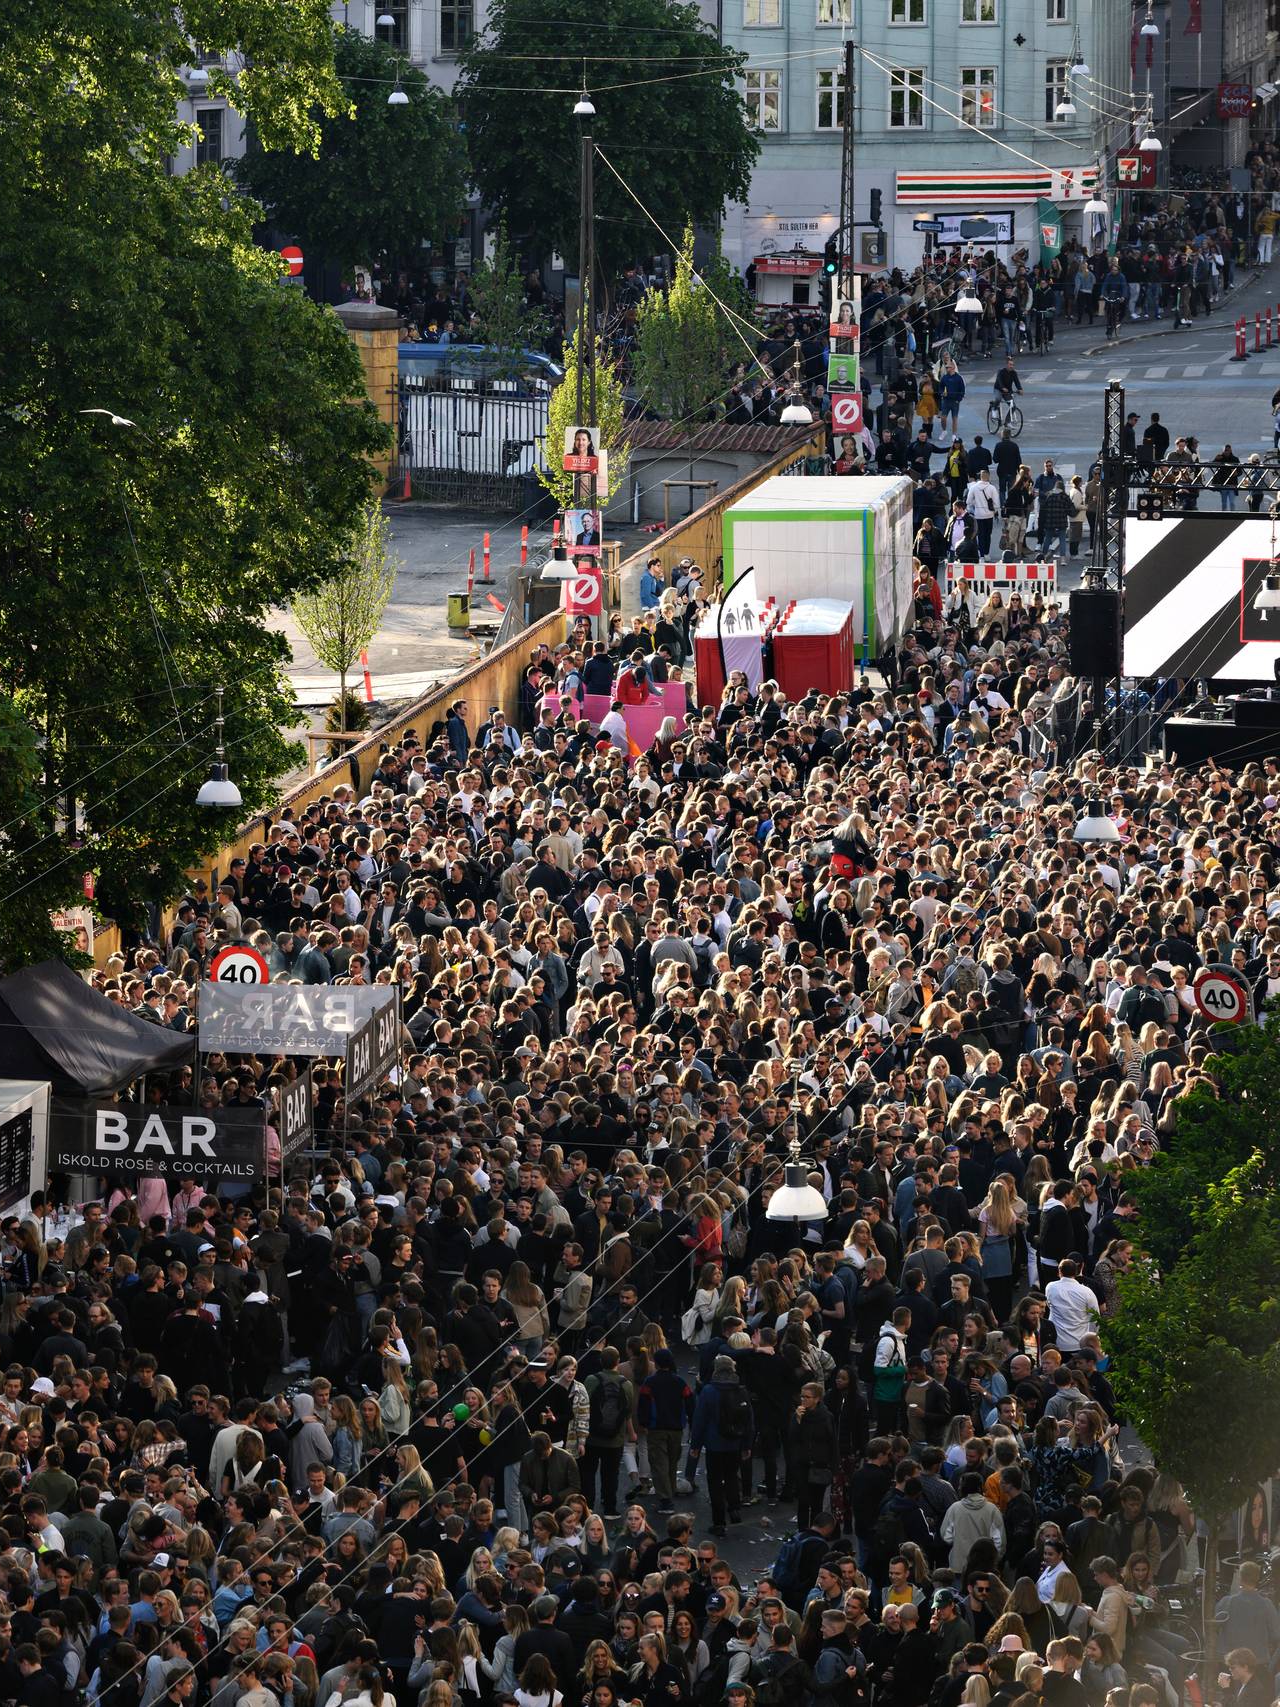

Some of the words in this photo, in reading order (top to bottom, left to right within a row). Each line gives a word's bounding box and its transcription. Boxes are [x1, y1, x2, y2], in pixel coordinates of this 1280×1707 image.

[220, 964, 257, 984] 40
[1204, 989, 1236, 1009] 40
[379, 1008, 395, 1057] BAR
[353, 1032, 370, 1084] BAR
[95, 1109, 217, 1157] BAR
[286, 1084, 306, 1137] BAR
[58, 1153, 110, 1168] ISKOLD
[115, 1157, 153, 1171] ROSÉ
[158, 1162, 168, 1171] &
[172, 1162, 255, 1176] COCKTAILS
